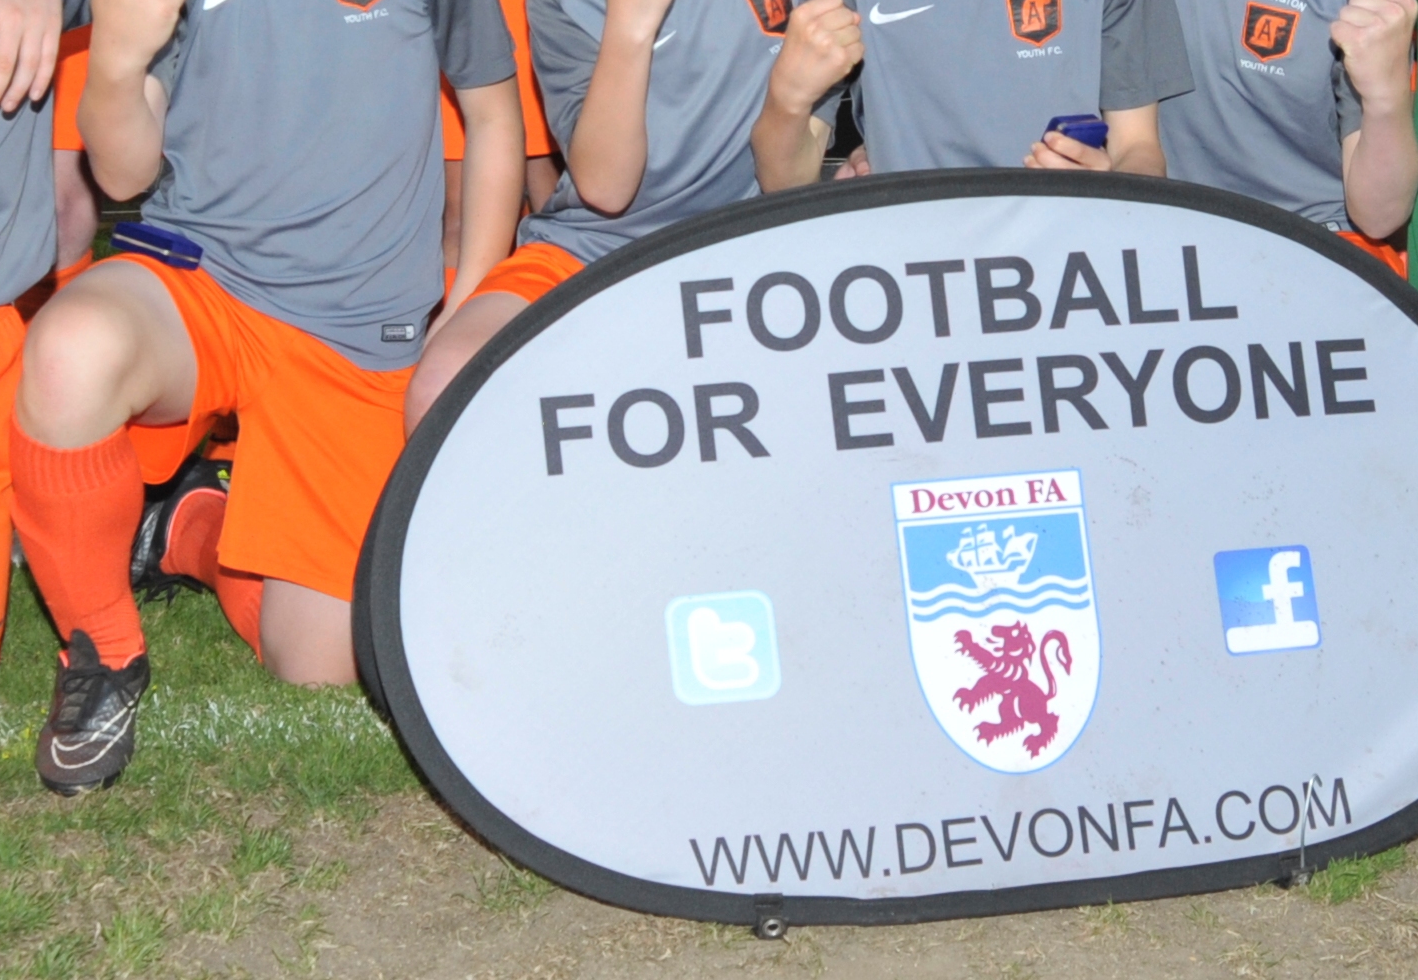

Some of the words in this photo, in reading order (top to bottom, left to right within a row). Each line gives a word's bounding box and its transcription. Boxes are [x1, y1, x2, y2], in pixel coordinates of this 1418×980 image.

[679, 244, 1237, 359] FOOTBALL
[538, 380, 770, 477] FOR
[827, 337, 1375, 451] EVERYONE
[909, 486, 1018, 514] Devon
[1025, 478, 1067, 504] FA
[689, 776, 1352, 886] WWW.DEVONFA.COM
